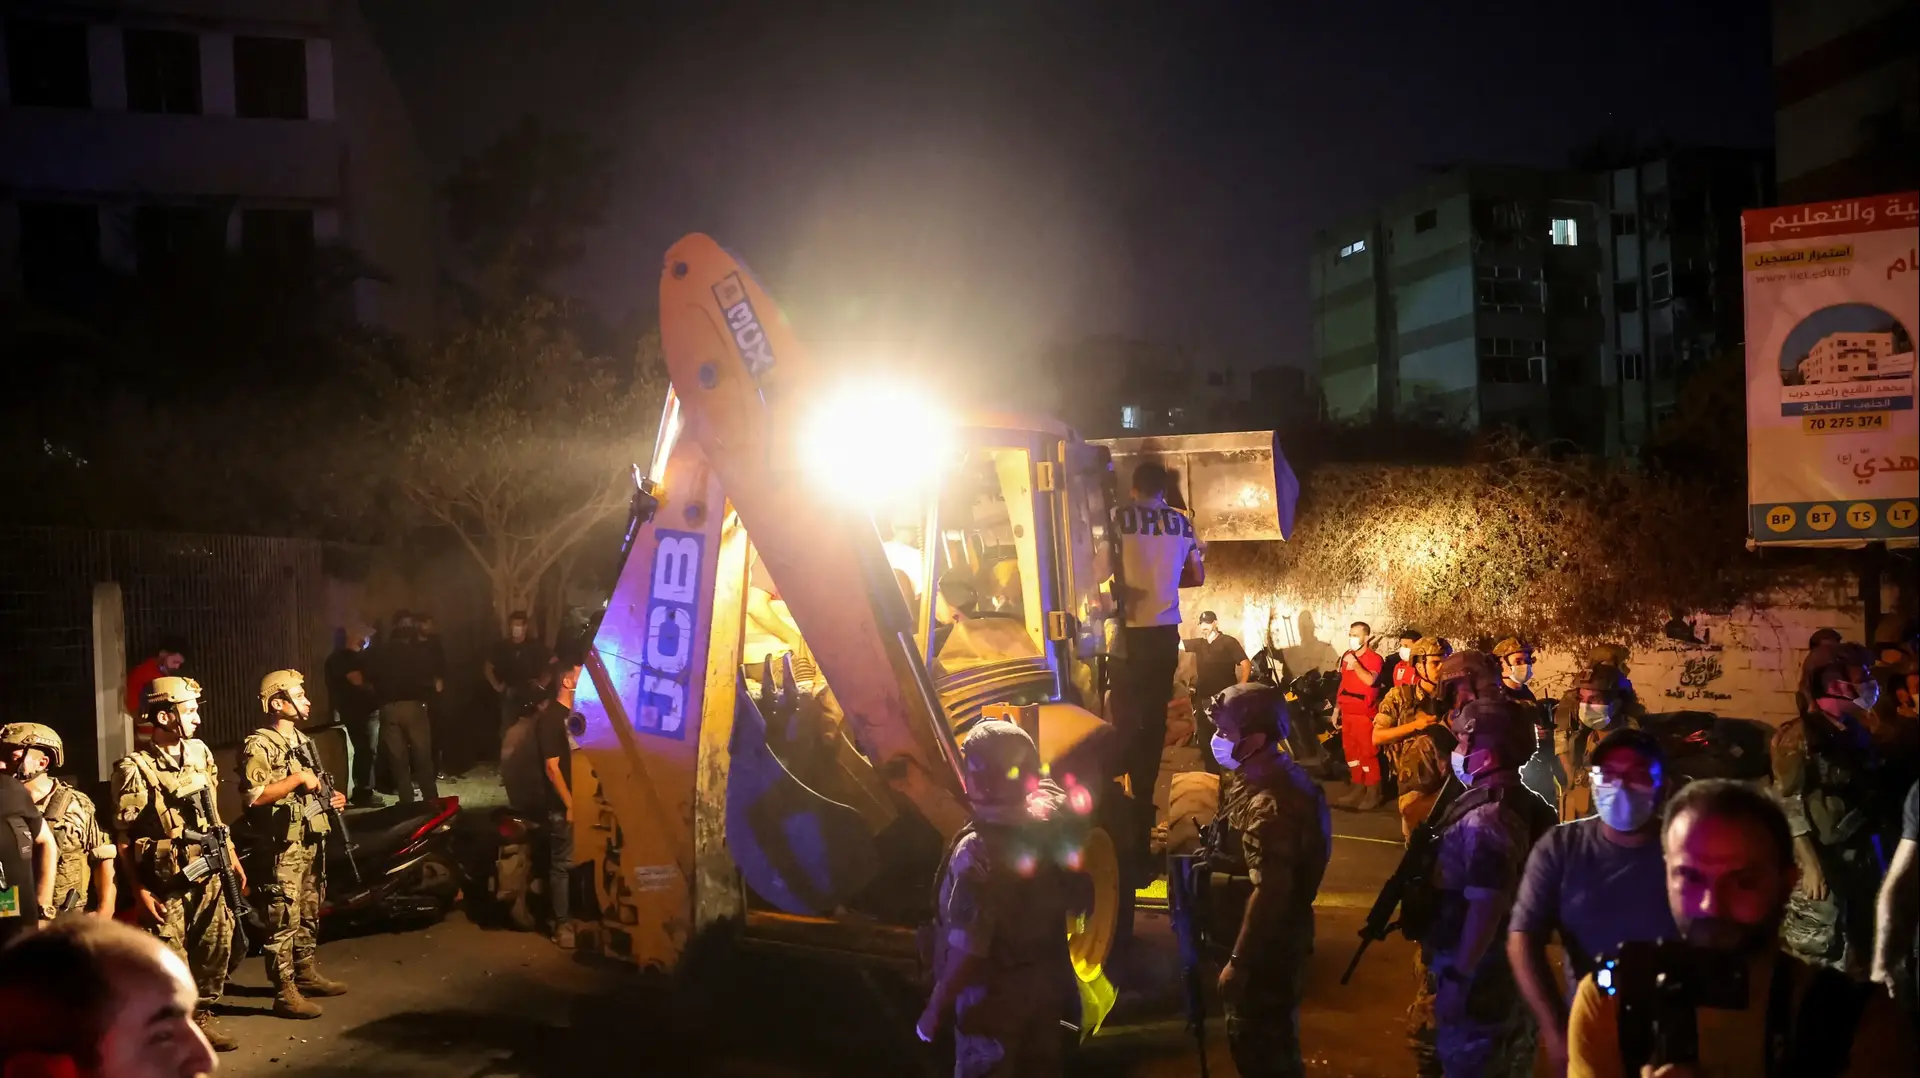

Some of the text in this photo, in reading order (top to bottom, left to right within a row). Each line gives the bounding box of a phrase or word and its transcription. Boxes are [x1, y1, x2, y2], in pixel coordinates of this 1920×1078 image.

[1769, 198, 1918, 234] ية والتعليم
[1754, 246, 1850, 267] استمرار التسجيل
[1886, 248, 1918, 280] ام
[1809, 415, 1882, 429] 70 275 374
[1771, 514, 1791, 525] BP
[1811, 512, 1831, 523] BT
[1852, 511, 1871, 522] TS
[1893, 509, 1911, 520] LT
[640, 536, 700, 732] JCB
